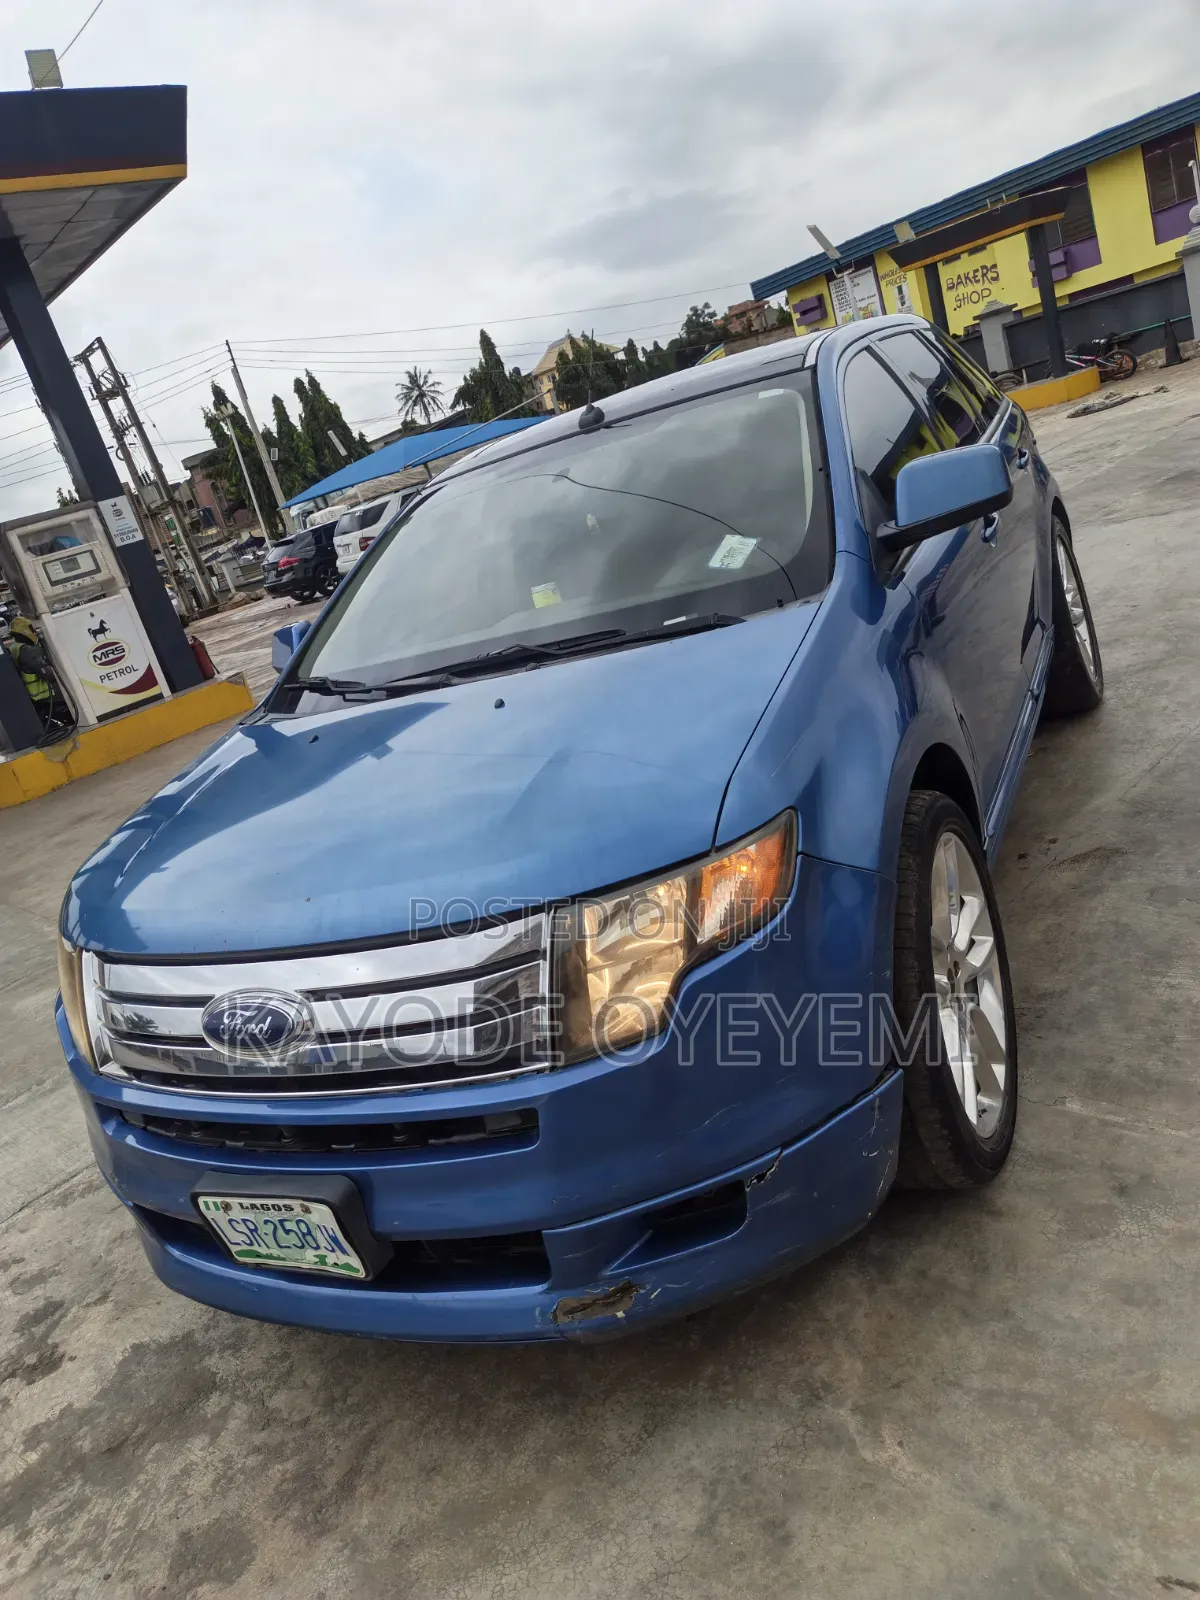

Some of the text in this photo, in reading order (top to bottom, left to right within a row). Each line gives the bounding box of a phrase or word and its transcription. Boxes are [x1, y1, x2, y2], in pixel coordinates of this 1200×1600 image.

[880, 267, 901, 282] WHOLES
[886, 272, 908, 288] PRICES
[946, 263, 1000, 291] BAKERS
[954, 287, 992, 309] SHOP
[92, 644, 126, 664] MRS
[99, 664, 139, 684] PETROL
[219, 1008, 273, 1040] Ford
[237, 1201, 295, 1212] LAGOS
